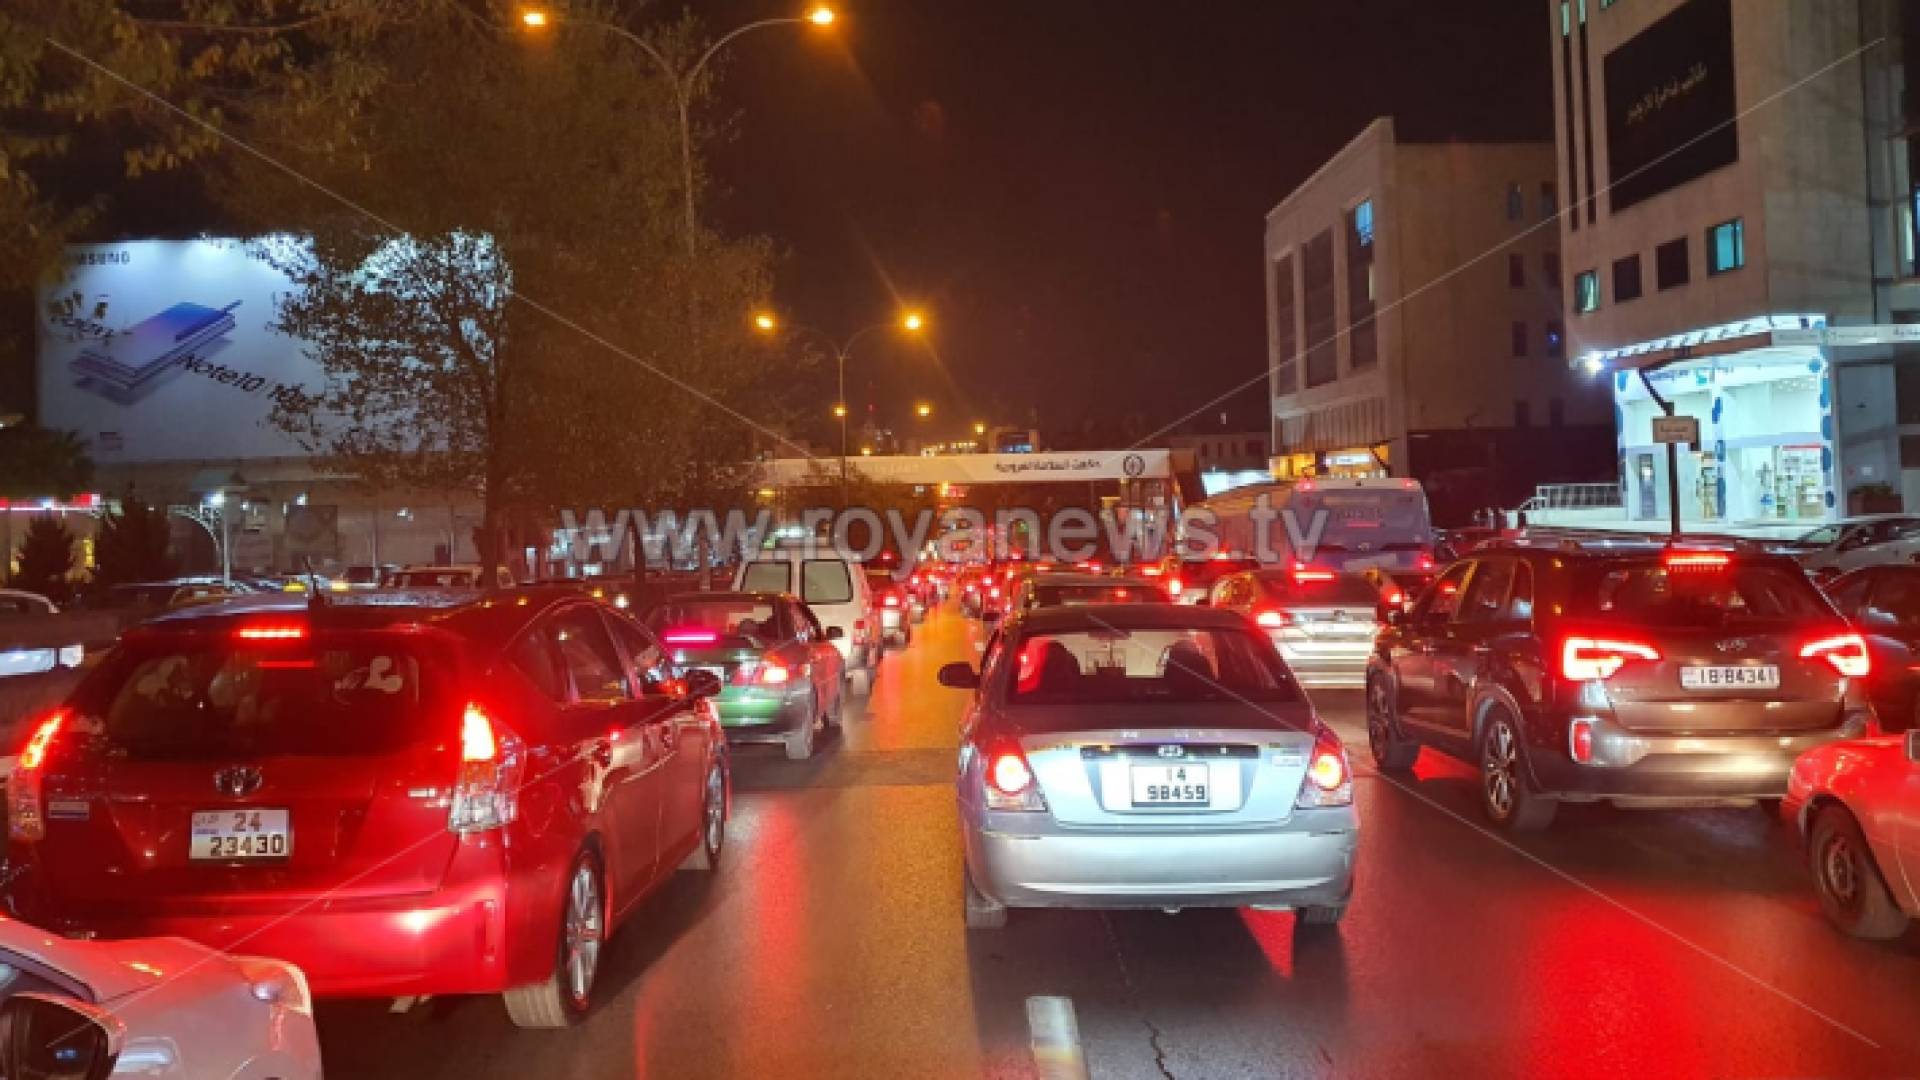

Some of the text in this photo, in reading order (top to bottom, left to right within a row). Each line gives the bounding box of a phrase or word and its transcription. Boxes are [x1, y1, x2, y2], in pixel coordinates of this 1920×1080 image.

[1146, 785, 1206, 800] 98459
[232, 812, 263, 833] 24
[209, 834, 285, 857] 23430
